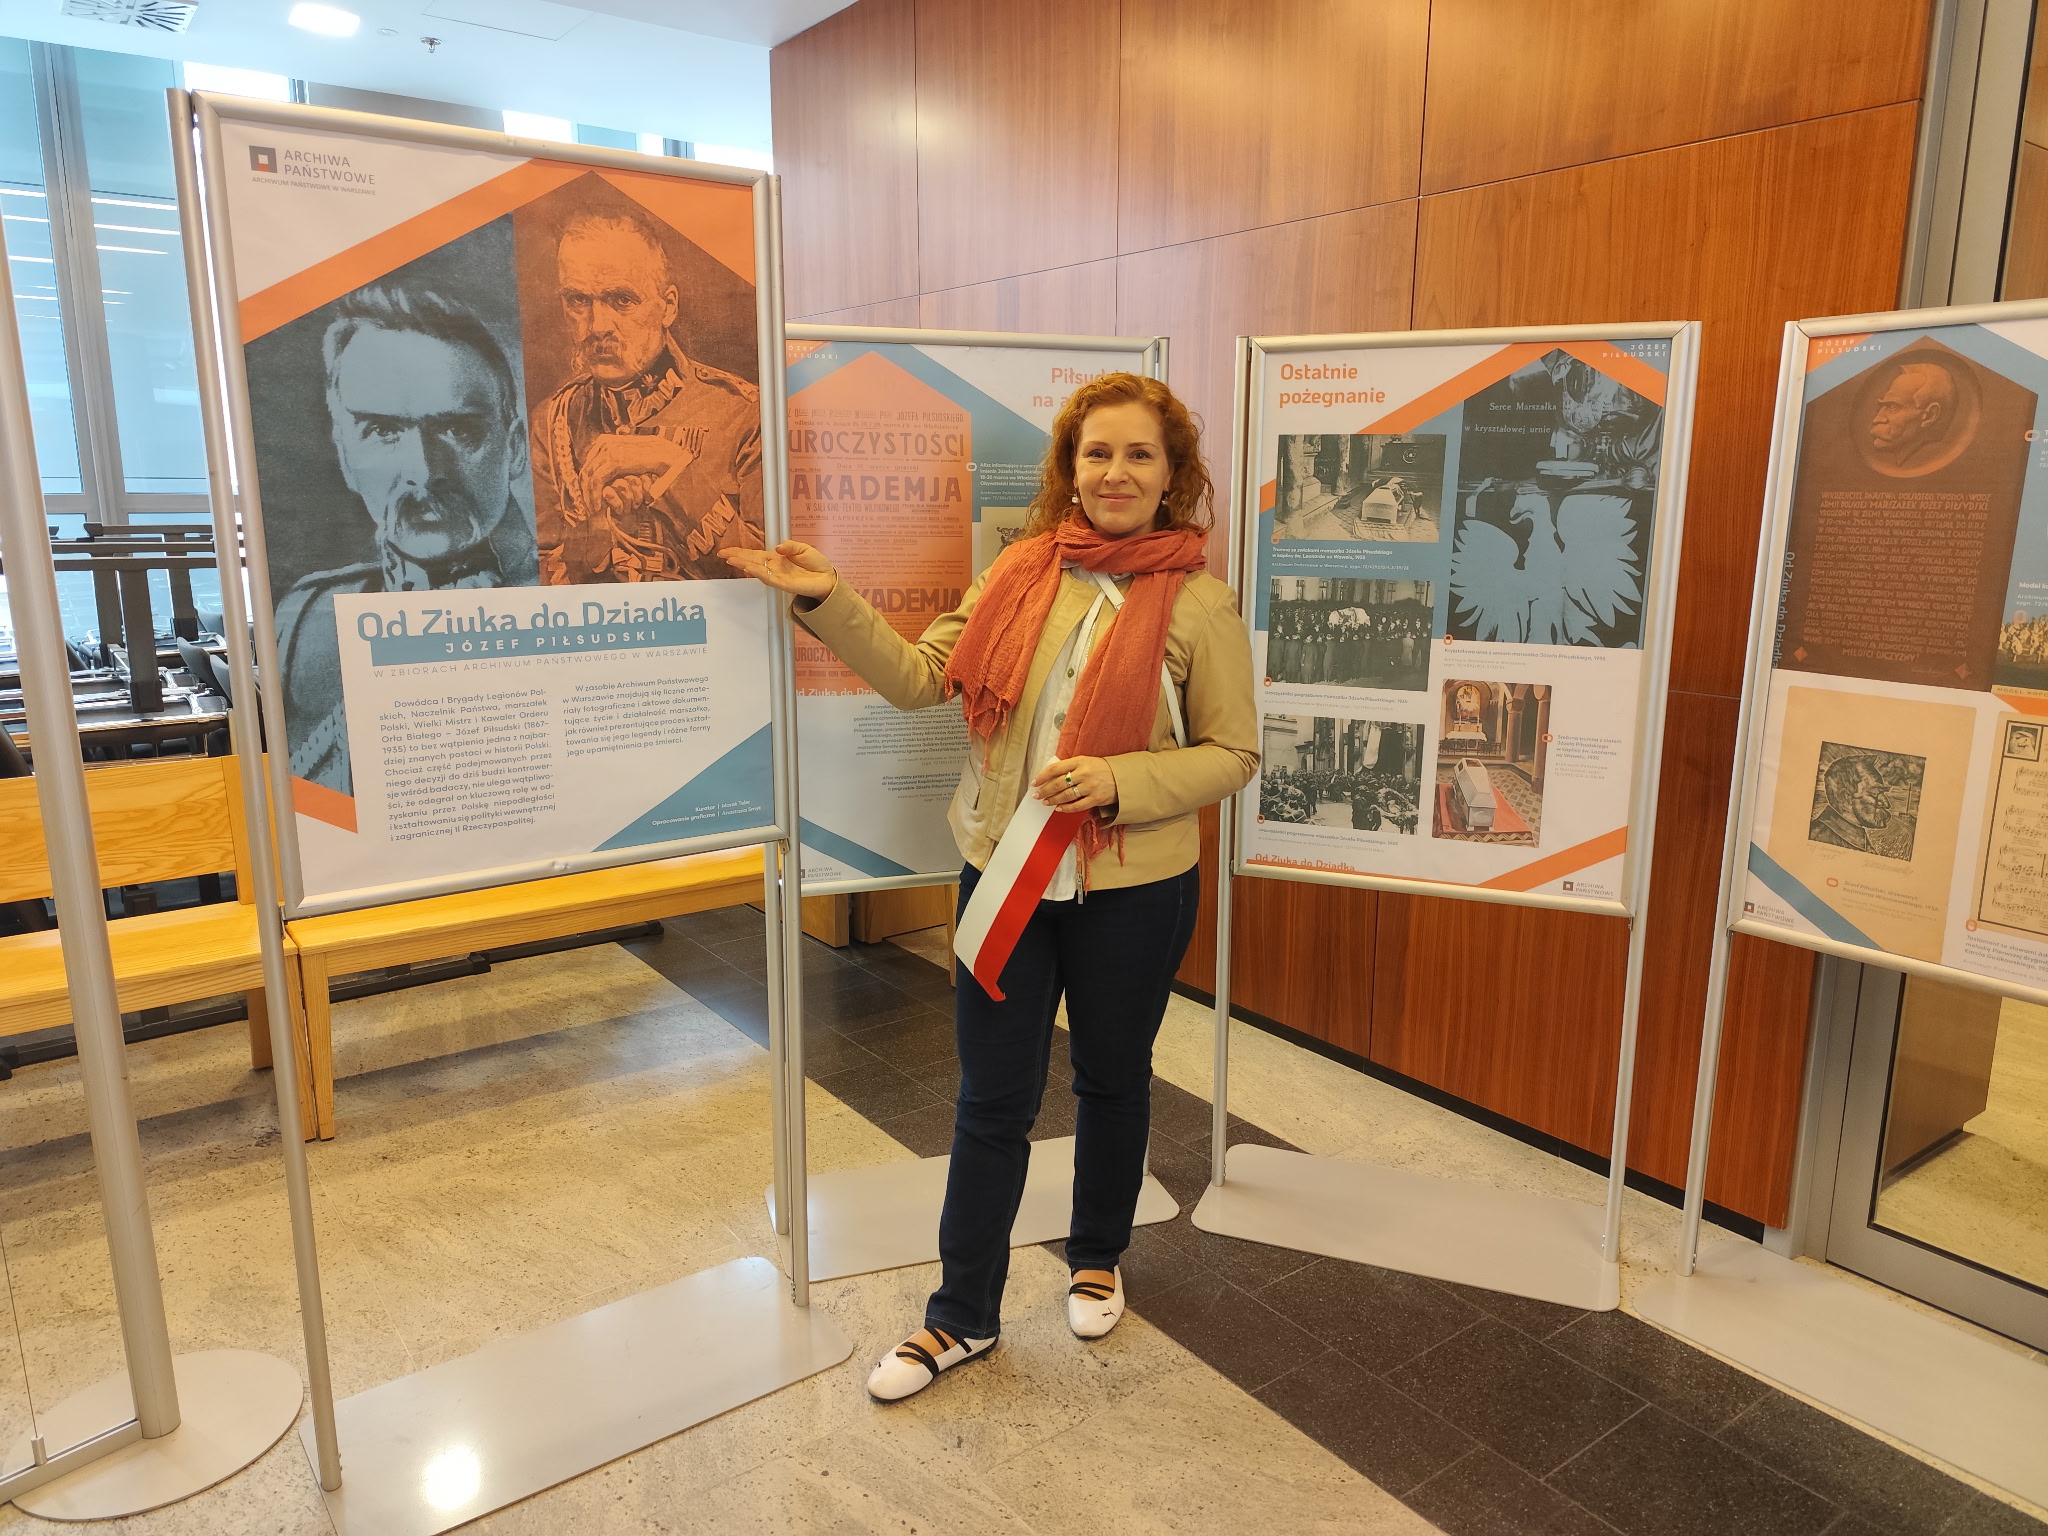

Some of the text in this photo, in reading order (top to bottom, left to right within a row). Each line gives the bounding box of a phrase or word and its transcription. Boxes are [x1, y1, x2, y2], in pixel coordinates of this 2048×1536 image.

[284, 150, 350, 167] ARCHIWA
[284, 164, 376, 184] PAŃSTWOWE
[252, 177, 289, 186] ARCHIWUM
[341, 186, 376, 195] WARSZAWIE
[1819, 339, 1854, 347] JÓZEF
[788, 352, 838, 360] IŁSUDSKI
[1281, 363, 1358, 380] Ostatnie
[1033, 395, 1053, 407] na
[1280, 387, 1385, 408] pożegnanie
[1489, 402, 1557, 411] Serce Marszałka
[1475, 425, 1526, 435] kryształowej
[789, 429, 963, 456] UROCZYSTOŚCI
[792, 474, 962, 502] AKADEMJA
[357, 596, 706, 641] Od Ziuka do Dziadka
[1772, 552, 1795, 669] Od Ziuka do Dziadka
[445, 630, 656, 653] JÓZEF PIŁSUDSKI
[373, 670, 383, 678] W
[391, 665, 457, 677] ZBIORACH
[464, 659, 531, 671] ARCHIWUM
[536, 652, 626, 665] PAŃSTWOWEGO
[646, 647, 708, 658] WARSZAWIE
[571, 693, 614, 703] Warszawie
[616, 690, 650, 700] znajdują
[686, 685, 710, 693] mate-
[585, 676, 709, 691] zasobie Archiwum Państwowego
[394, 688, 547, 708] Dowódca Brygady Legionów Pol-
[563, 696, 710, 715] riały fotograficzne aktowe dokumen-
[379, 699, 548, 720] skich, Naczelnik Państwa, marszałek
[564, 705, 711, 726] tujące życie działalność marszałka,
[380, 711, 549, 732] Polski, Wielki Mistrz Kawaler Orderu
[381, 720, 549, 743] Orła Białego Józef Piłsudski (1867–
[578, 714, 711, 734] również prezentujące proces kształ-
[383, 732, 550, 754] 1935) wątpienia jedna najbar-
[566, 725, 712, 746] towania jego legendy różne formy
[383, 741, 552, 765] dziej znanych postaci historii Polski.
[567, 736, 684, 758] jego upamiętnienia śmierci.
[385, 753, 553, 776] Chociaż część podejmowanych przez
[386, 764, 553, 788] niego decyzji dziś budzi kontrower-
[400, 774, 554, 797] wśród badaczy, ulega wątpliwo-
[388, 786, 529, 809] ści, odegrał kluczową rolę
[389, 793, 556, 821] zyskaniu przez Polskę niepodległości
[393, 803, 557, 830] kształtowaniu polityki wewnętrznej
[652, 816, 689, 826] Opracowanie
[690, 812, 716, 821] graficzne
[395, 816, 536, 841] zagranicznej Rzeczypospolitej.
[1255, 853, 1355, 871] Od Ziuka do Dziadka
[1967, 935, 1999, 947] Testament
[1964, 948, 1985, 957] Karola
[1992, 948, 2022, 960] Pierwszej
